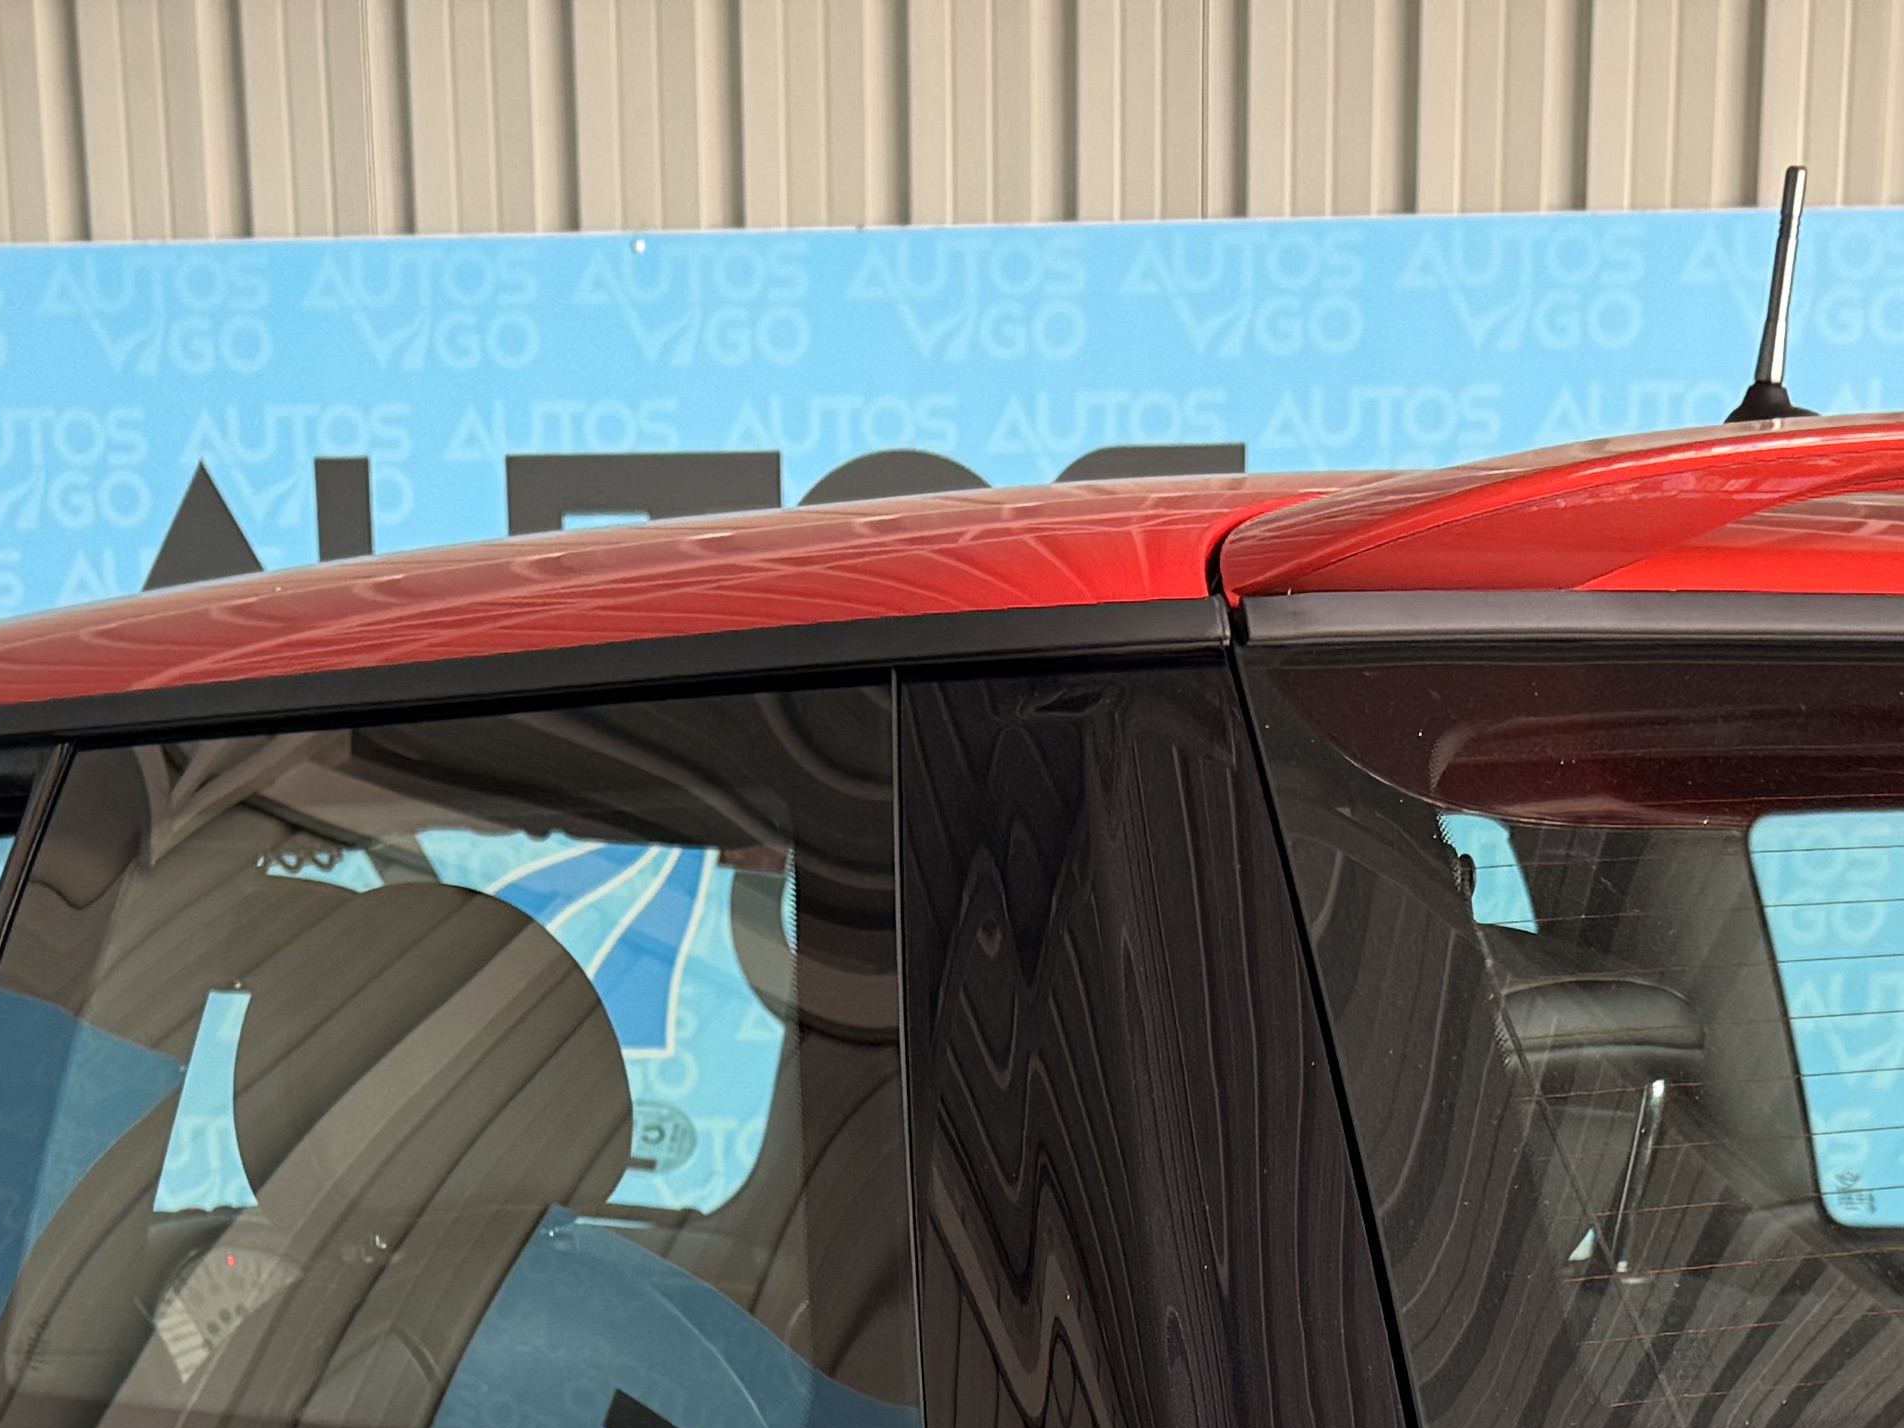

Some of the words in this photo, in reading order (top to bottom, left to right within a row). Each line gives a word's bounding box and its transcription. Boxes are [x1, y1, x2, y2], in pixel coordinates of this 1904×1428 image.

[34, 252, 273, 315] AUTOS
[304, 248, 541, 311] AUTOS
[571, 241, 809, 305] AUTOS
[845, 237, 1087, 300] AUTOS
[1118, 231, 1364, 296] AUTOS
[1397, 223, 1645, 291] AUTOS
[86, 312, 275, 377] VIGO
[350, 307, 541, 372] VIGO
[620, 302, 812, 367] VIGO
[896, 297, 1088, 361] VIGO
[1166, 293, 1364, 357] VIGO
[1448, 288, 1644, 351] VIGO
[1259, 384, 1504, 450] AUTOS
[228, 462, 413, 527] VIO
